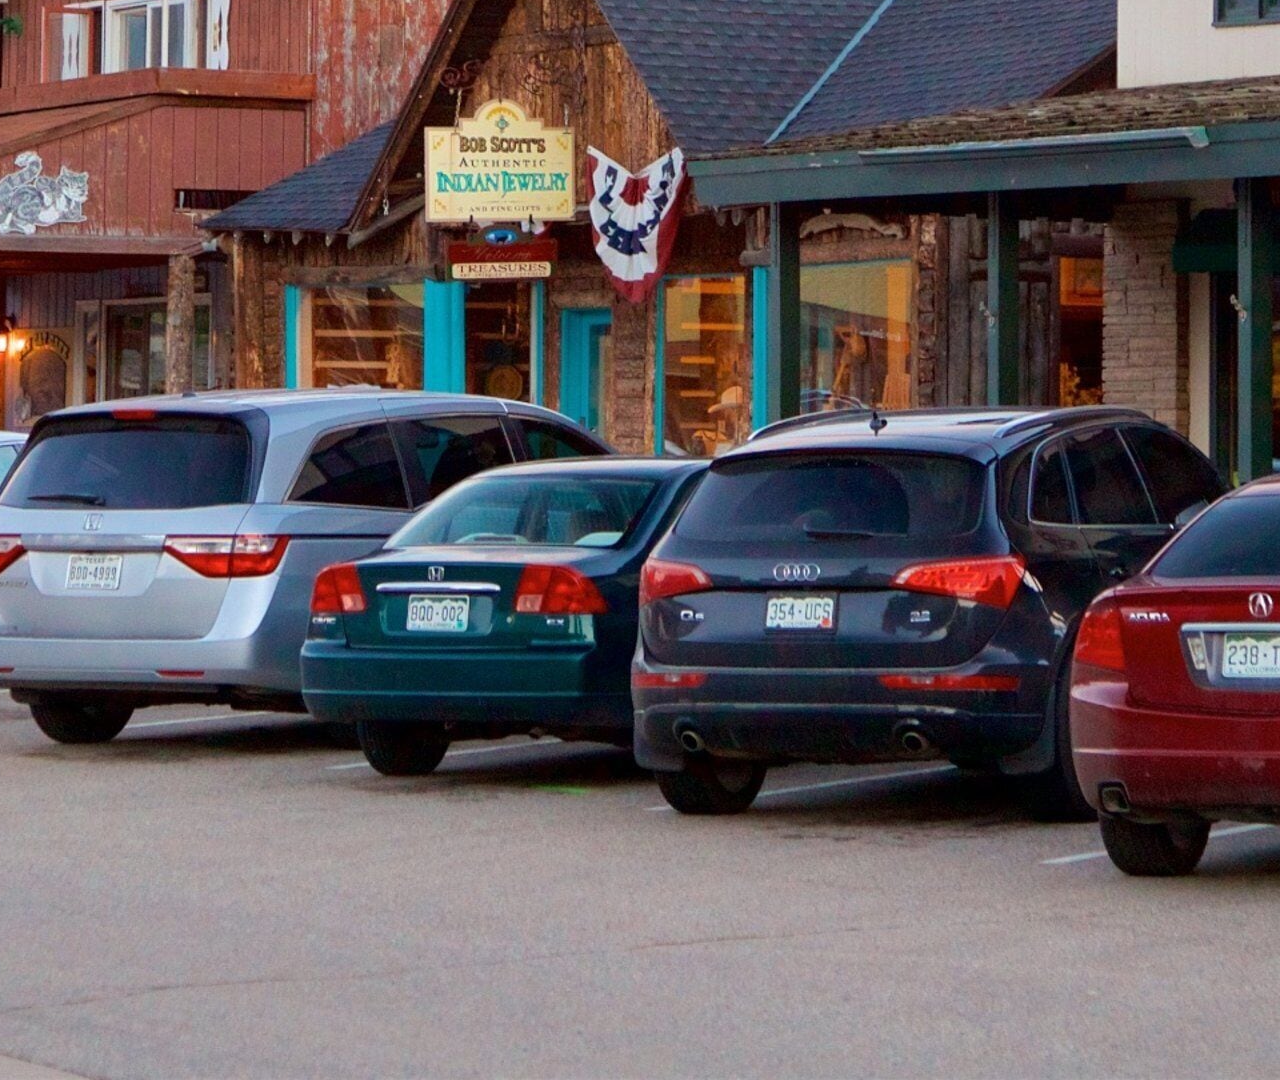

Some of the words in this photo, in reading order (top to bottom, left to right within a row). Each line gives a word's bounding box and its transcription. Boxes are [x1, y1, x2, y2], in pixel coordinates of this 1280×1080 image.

[458, 136, 488, 154] BOB
[490, 136, 547, 154] SCOTT'S
[458, 157, 547, 168] AUTHENTIC
[436, 171, 500, 194] INDIAN
[501, 171, 570, 199] JEWELRY
[459, 263, 547, 273] TREASURES
